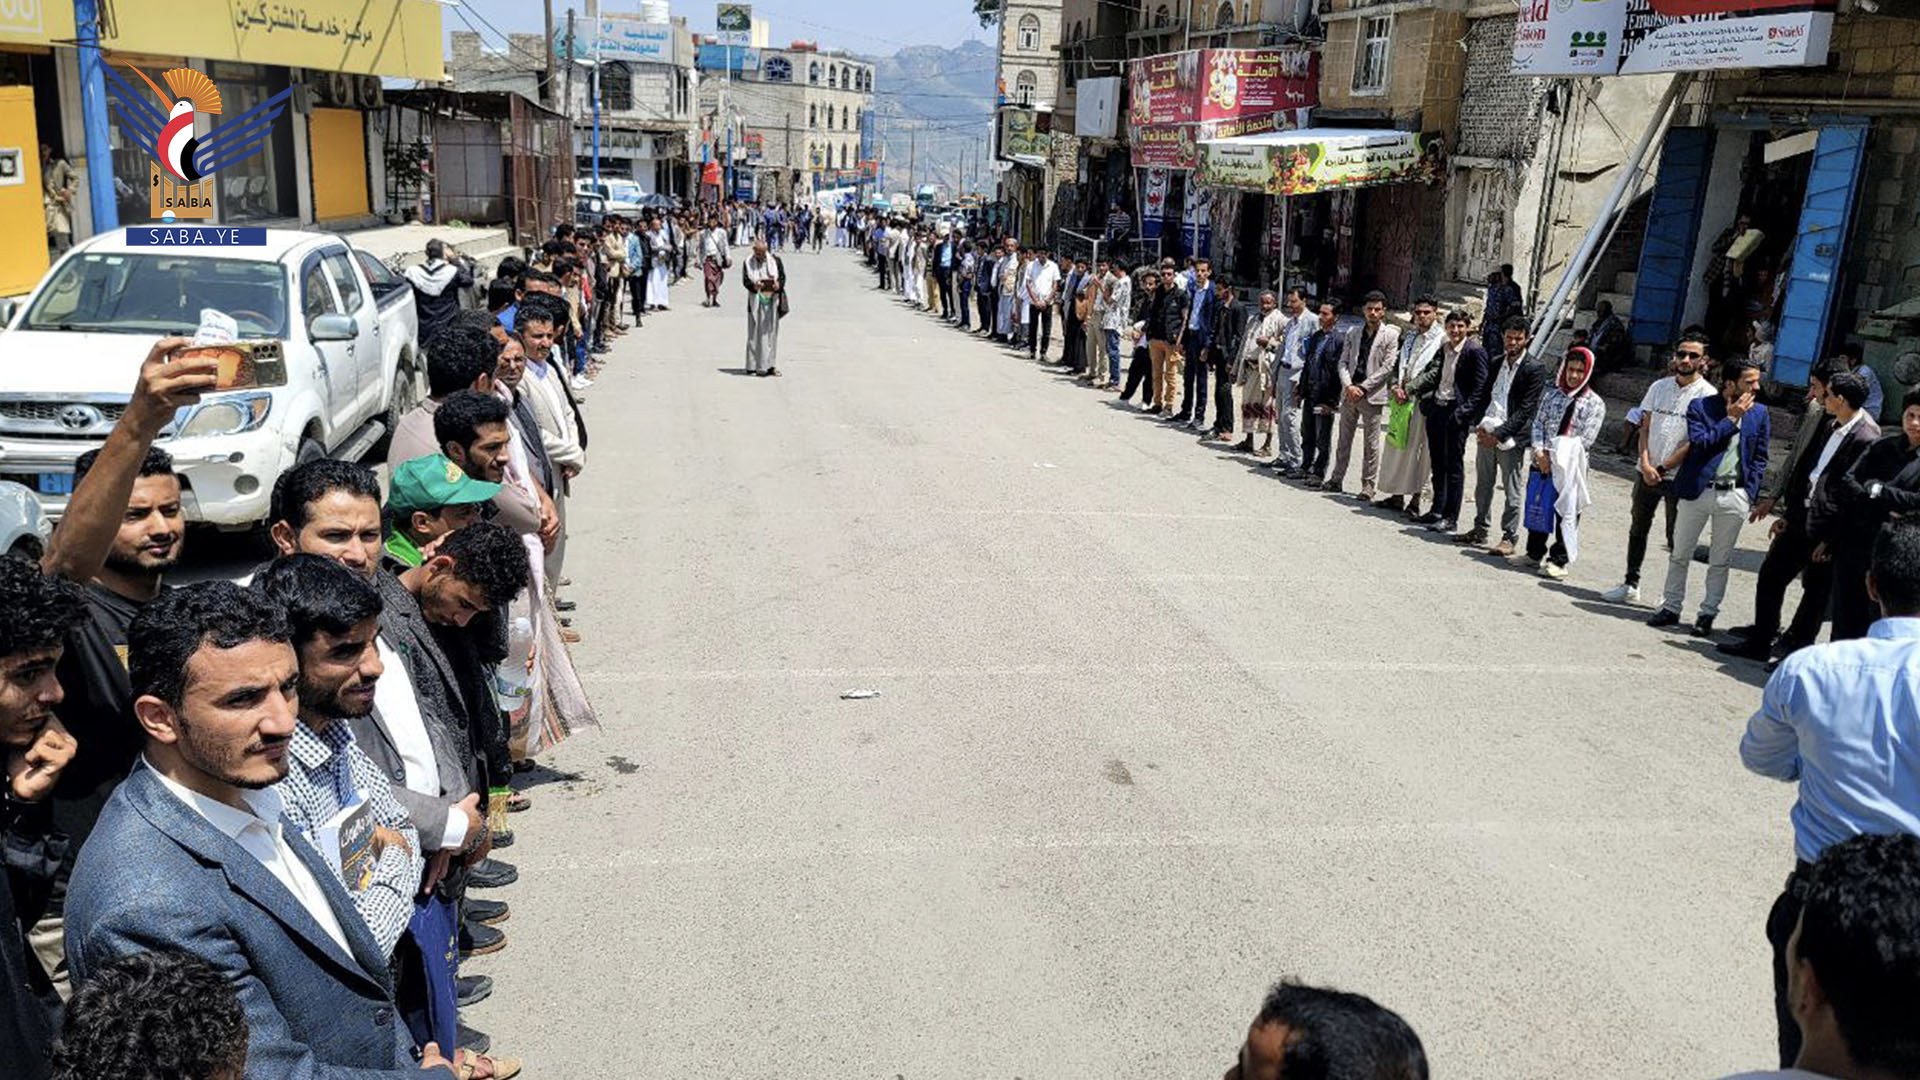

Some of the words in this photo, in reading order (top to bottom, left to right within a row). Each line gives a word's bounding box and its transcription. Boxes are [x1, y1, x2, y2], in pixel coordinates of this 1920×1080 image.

[236, 0, 299, 33] المشتركين
[301, 10, 341, 36] خدمة
[343, 19, 372, 47] مركز
[1239, 51, 1280, 63] ملحمة
[1247, 116, 1273, 132] ملحمة
